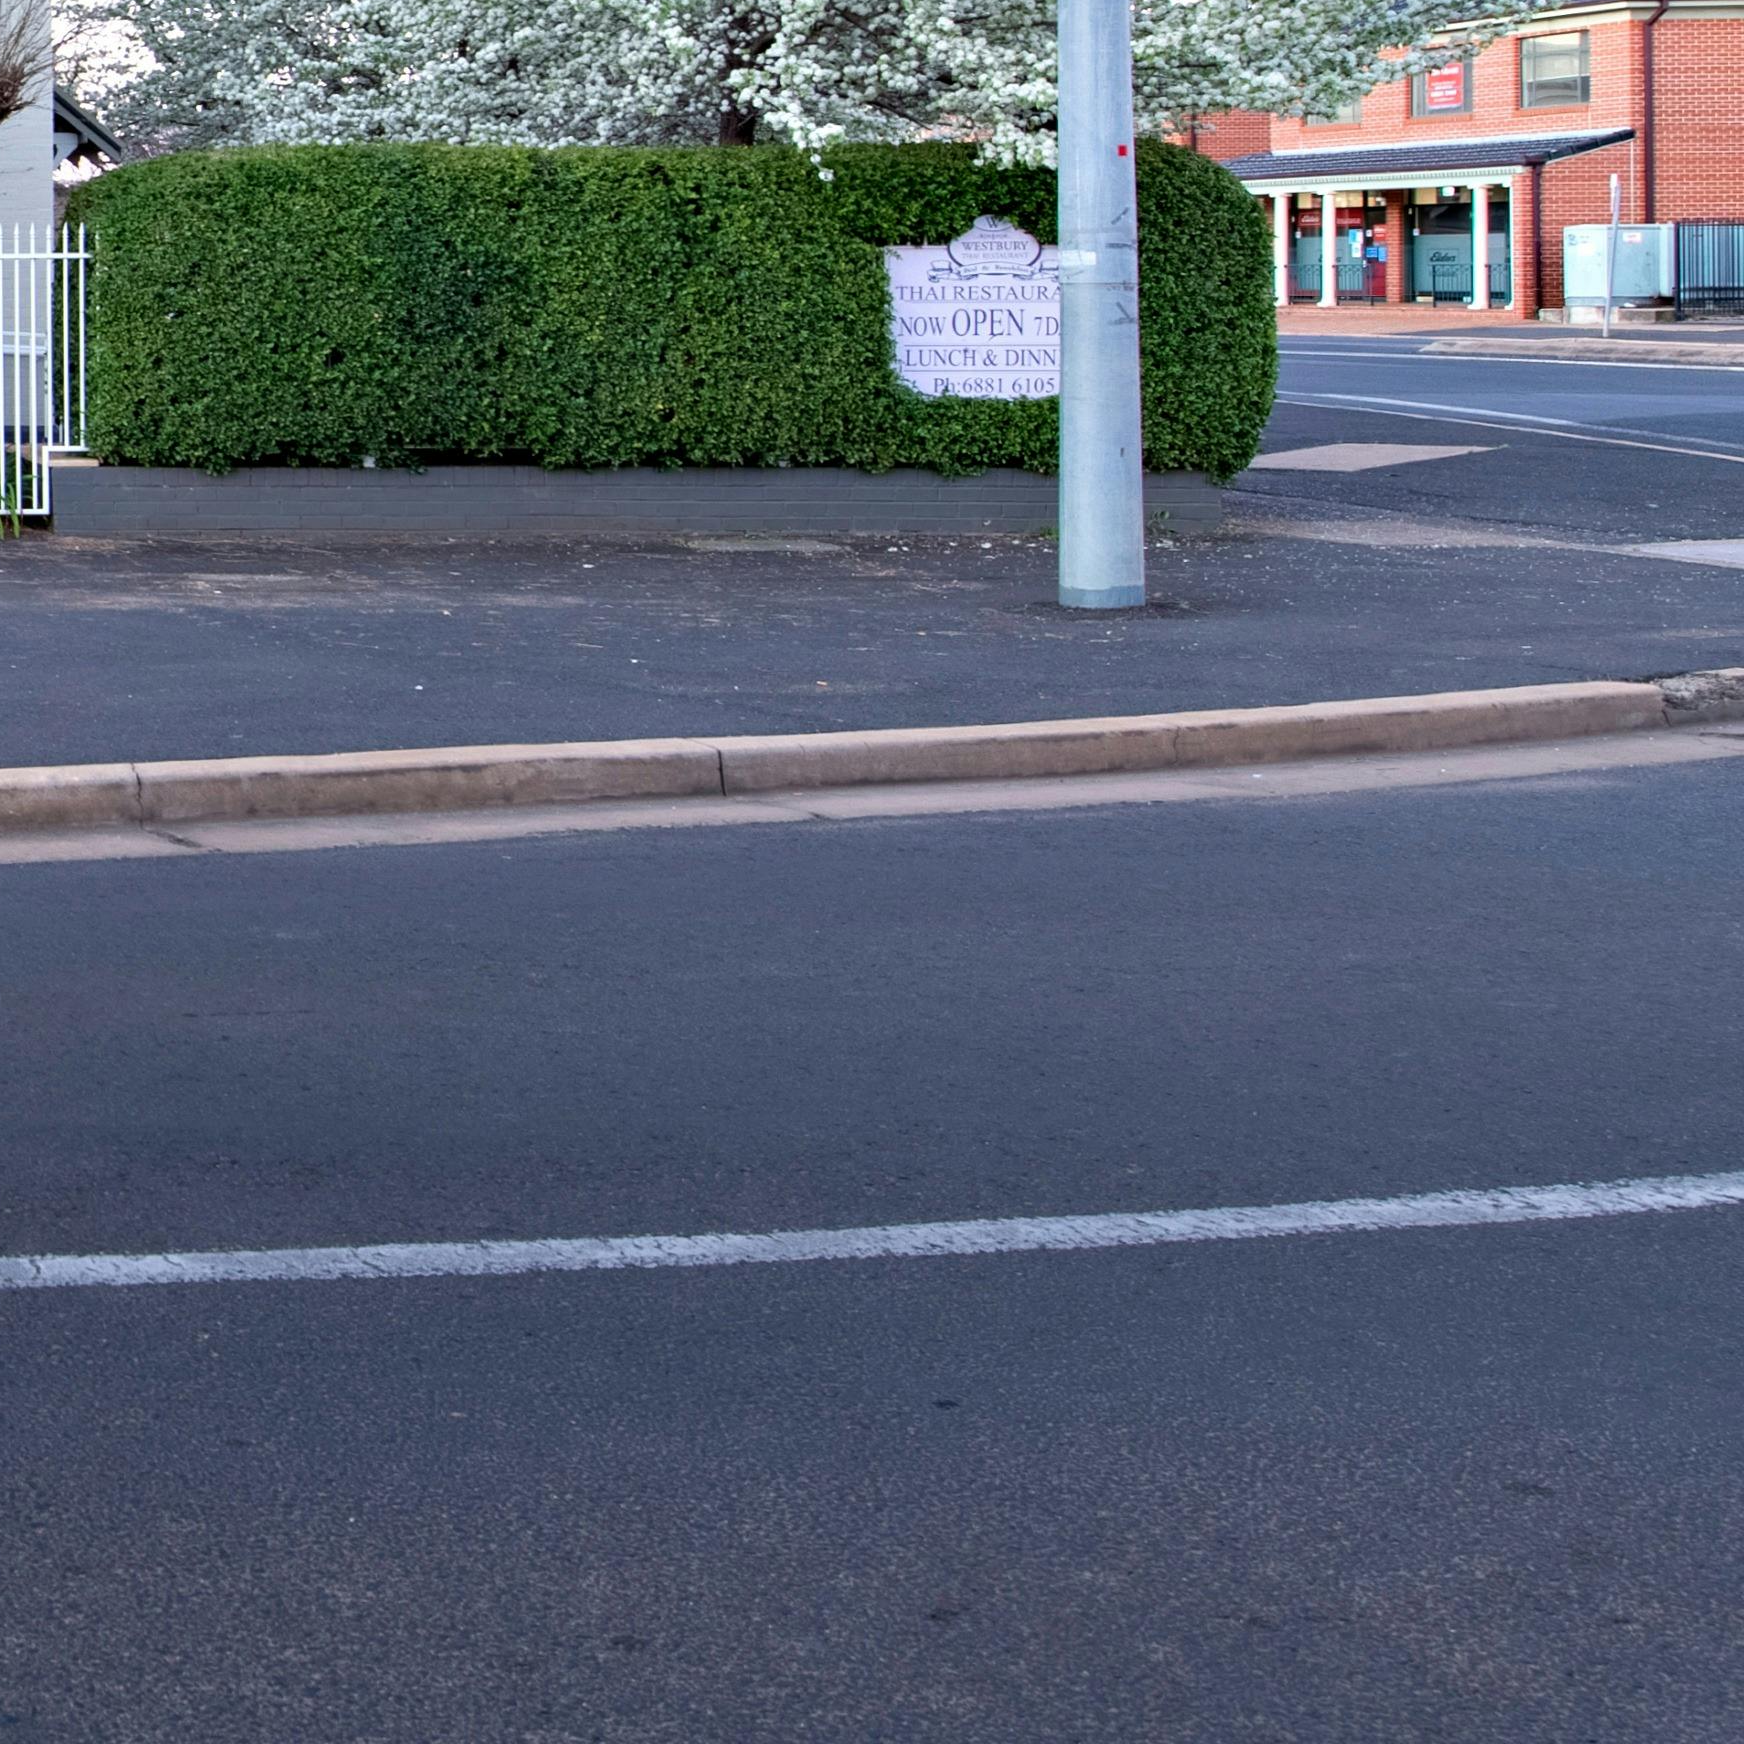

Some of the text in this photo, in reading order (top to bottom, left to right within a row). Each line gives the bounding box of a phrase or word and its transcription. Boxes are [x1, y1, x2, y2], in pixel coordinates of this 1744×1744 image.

[960, 240, 1029, 252] WESTBURY
[895, 285, 1061, 301] THAI RESTAURA
[897, 316, 946, 337] NOW
[952, 308, 1026, 337] OPEN
[1034, 316, 1043, 337] 7
[905, 348, 1060, 367] LUNCH & DINN
[1011, 377, 1056, 394] 6105
